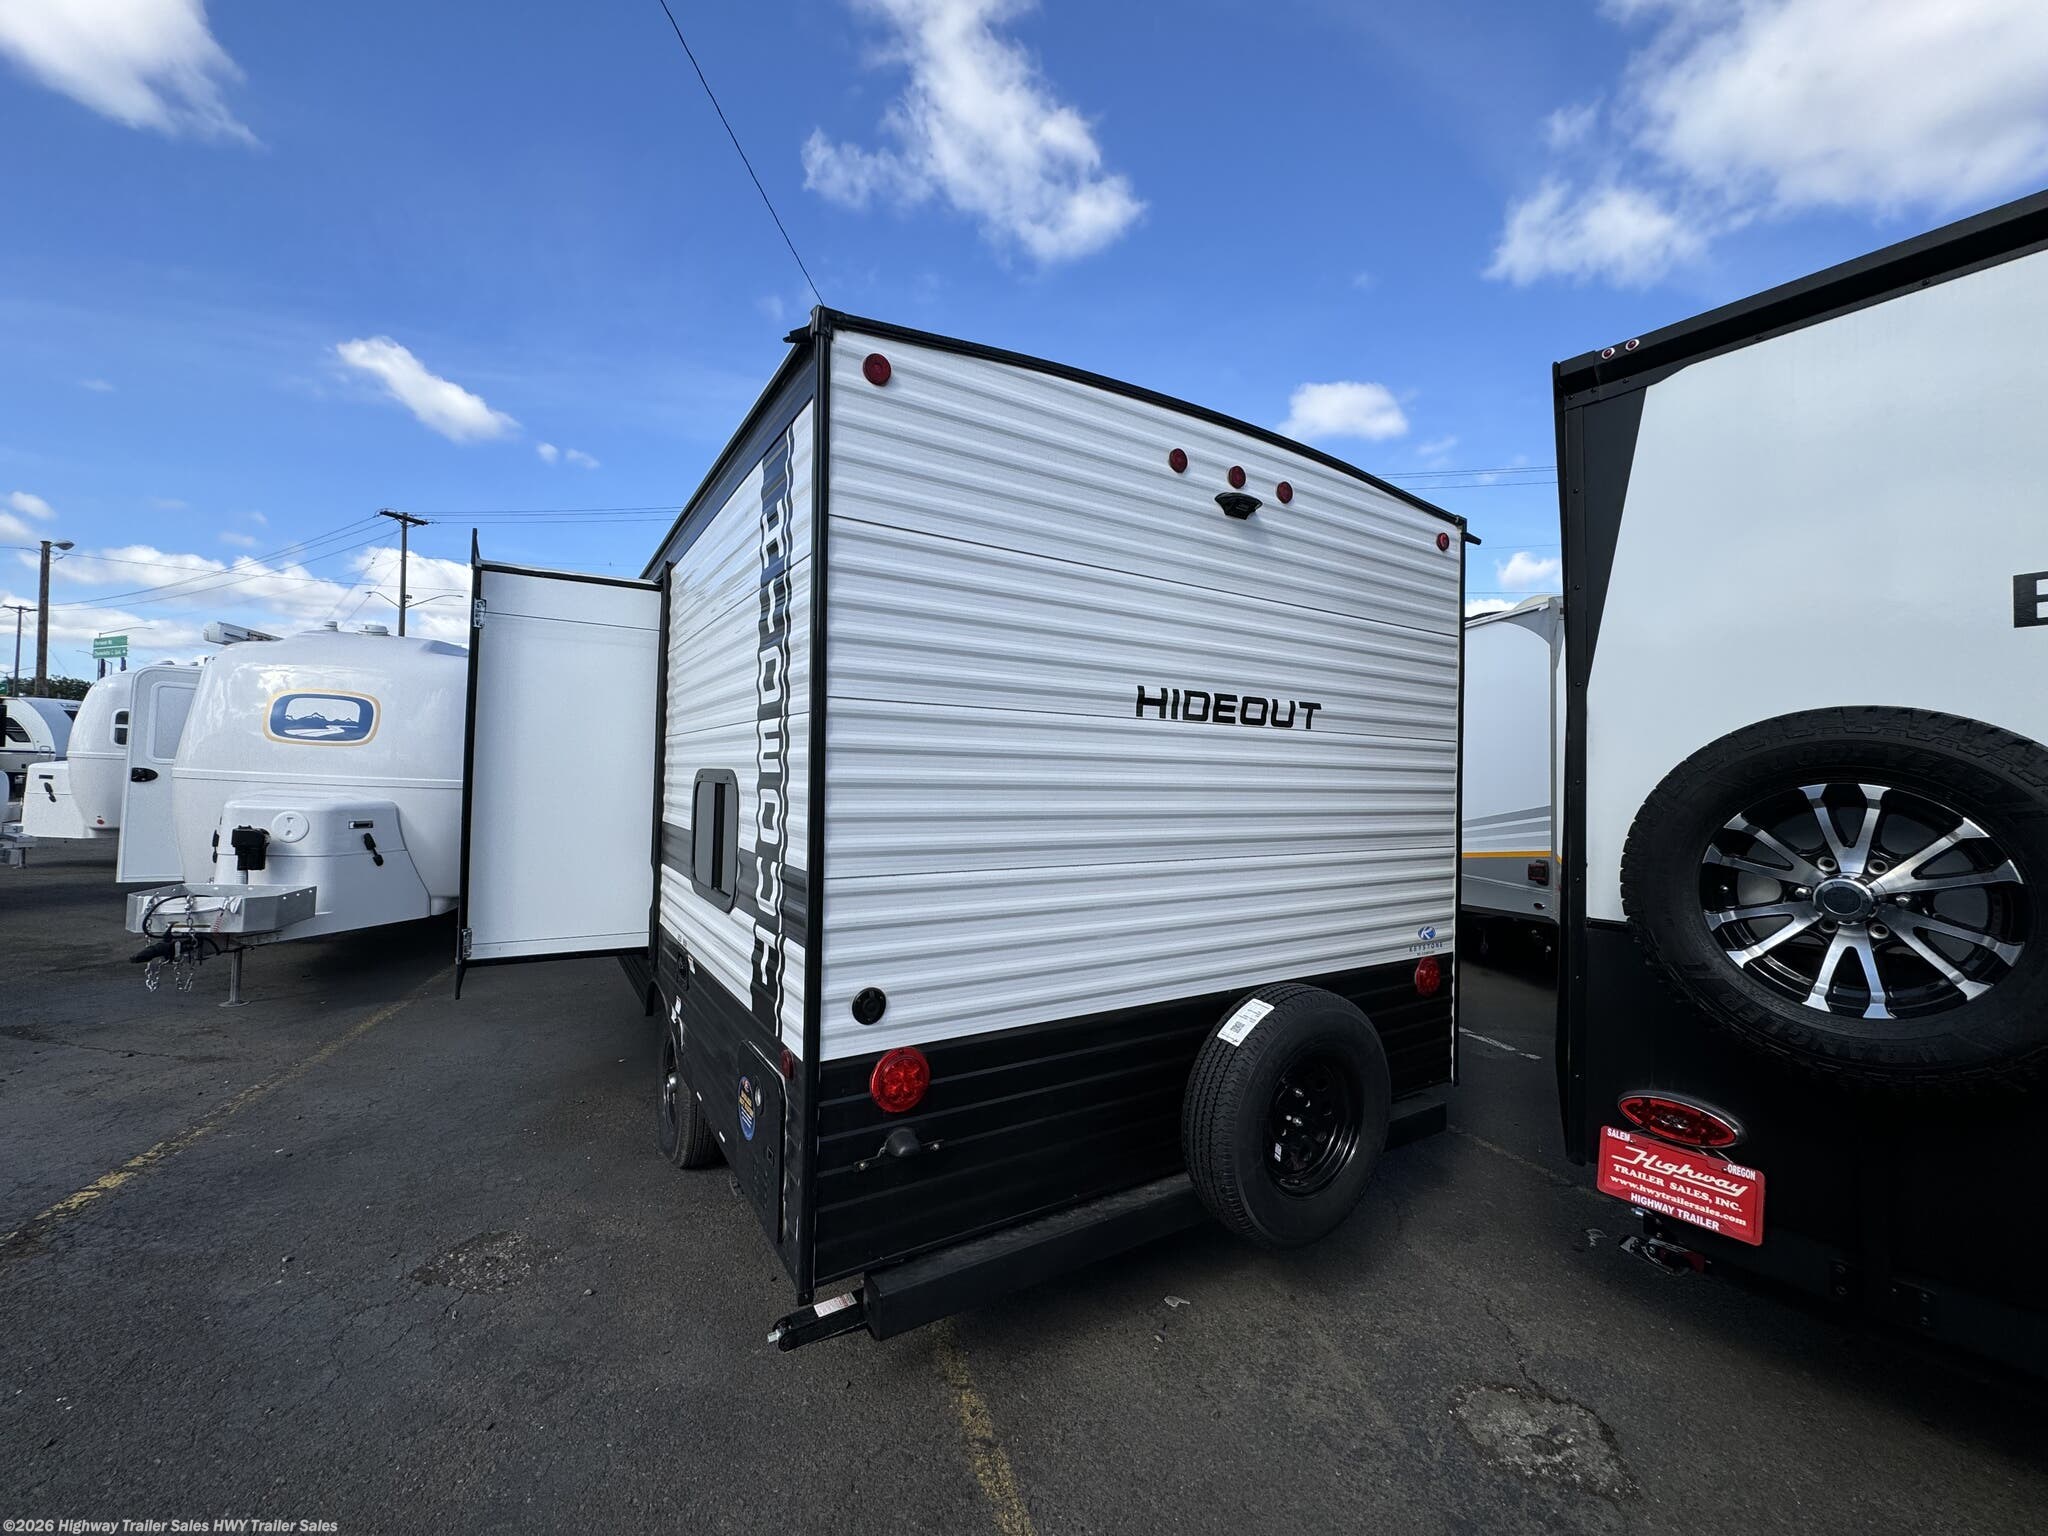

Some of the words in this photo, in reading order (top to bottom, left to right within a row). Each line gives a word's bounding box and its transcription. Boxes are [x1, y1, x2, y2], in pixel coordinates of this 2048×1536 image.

[1136, 685, 1322, 730] HIDEOUT
[756, 498, 785, 986] HIDEOUT
[1607, 1127, 1631, 1142] SALEM
[1611, 1145, 1749, 1197] Highway
[1613, 1163, 1665, 1187] TRAILER
[1669, 1181, 1713, 1204] SALES,
[1715, 1196, 1743, 1213] INC.
[1727, 1163, 1756, 1180] OREGON
[1610, 1175, 1747, 1227] www.hwytrailersales.com
[1631, 1192, 1675, 1215] HIGHWAY
[1676, 1207, 1720, 1231] TRAILER
